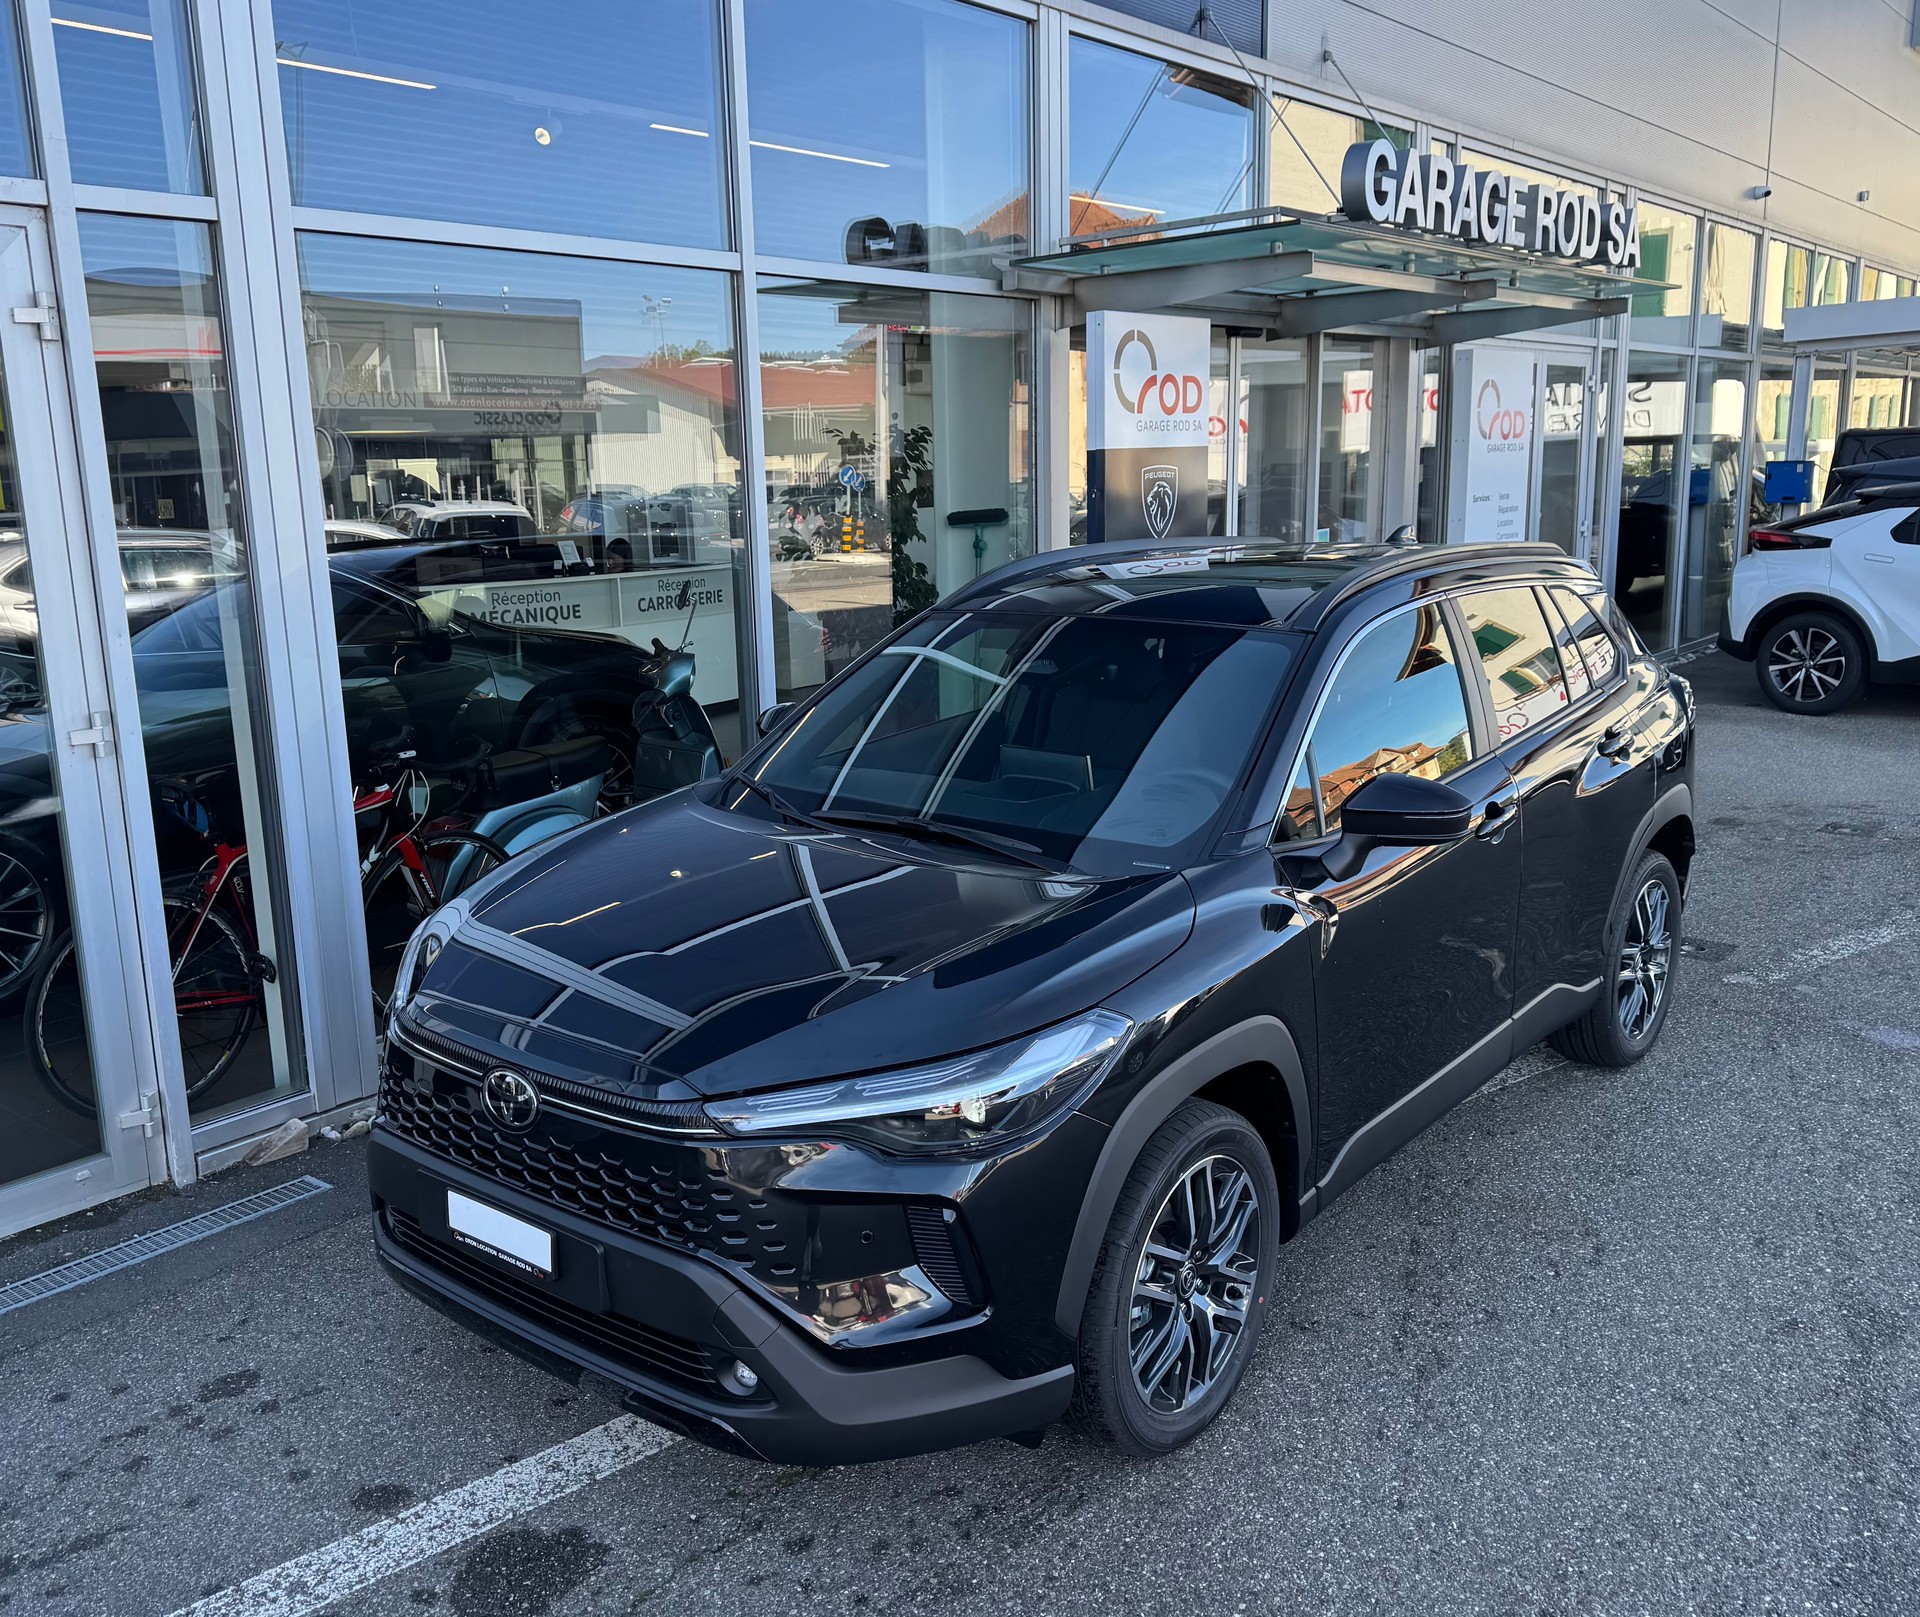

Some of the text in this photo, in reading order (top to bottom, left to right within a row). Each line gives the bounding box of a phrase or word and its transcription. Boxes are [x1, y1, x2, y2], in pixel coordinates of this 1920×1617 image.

[1363, 138, 1641, 268] GARAGE ROD SA
[460, 375, 478, 384] types
[315, 390, 417, 408] LOCATION
[1136, 419, 1203, 432] GARAGE ROD SA
[1487, 443, 1506, 453] GARAGE
[1144, 471, 1175, 480] PEUGEOT
[491, 589, 561, 607] Réception
[477, 1243, 498, 1256] LOCATION
[498, 1252, 516, 1265] GARAGE
[516, 1259, 526, 1269] ROD
